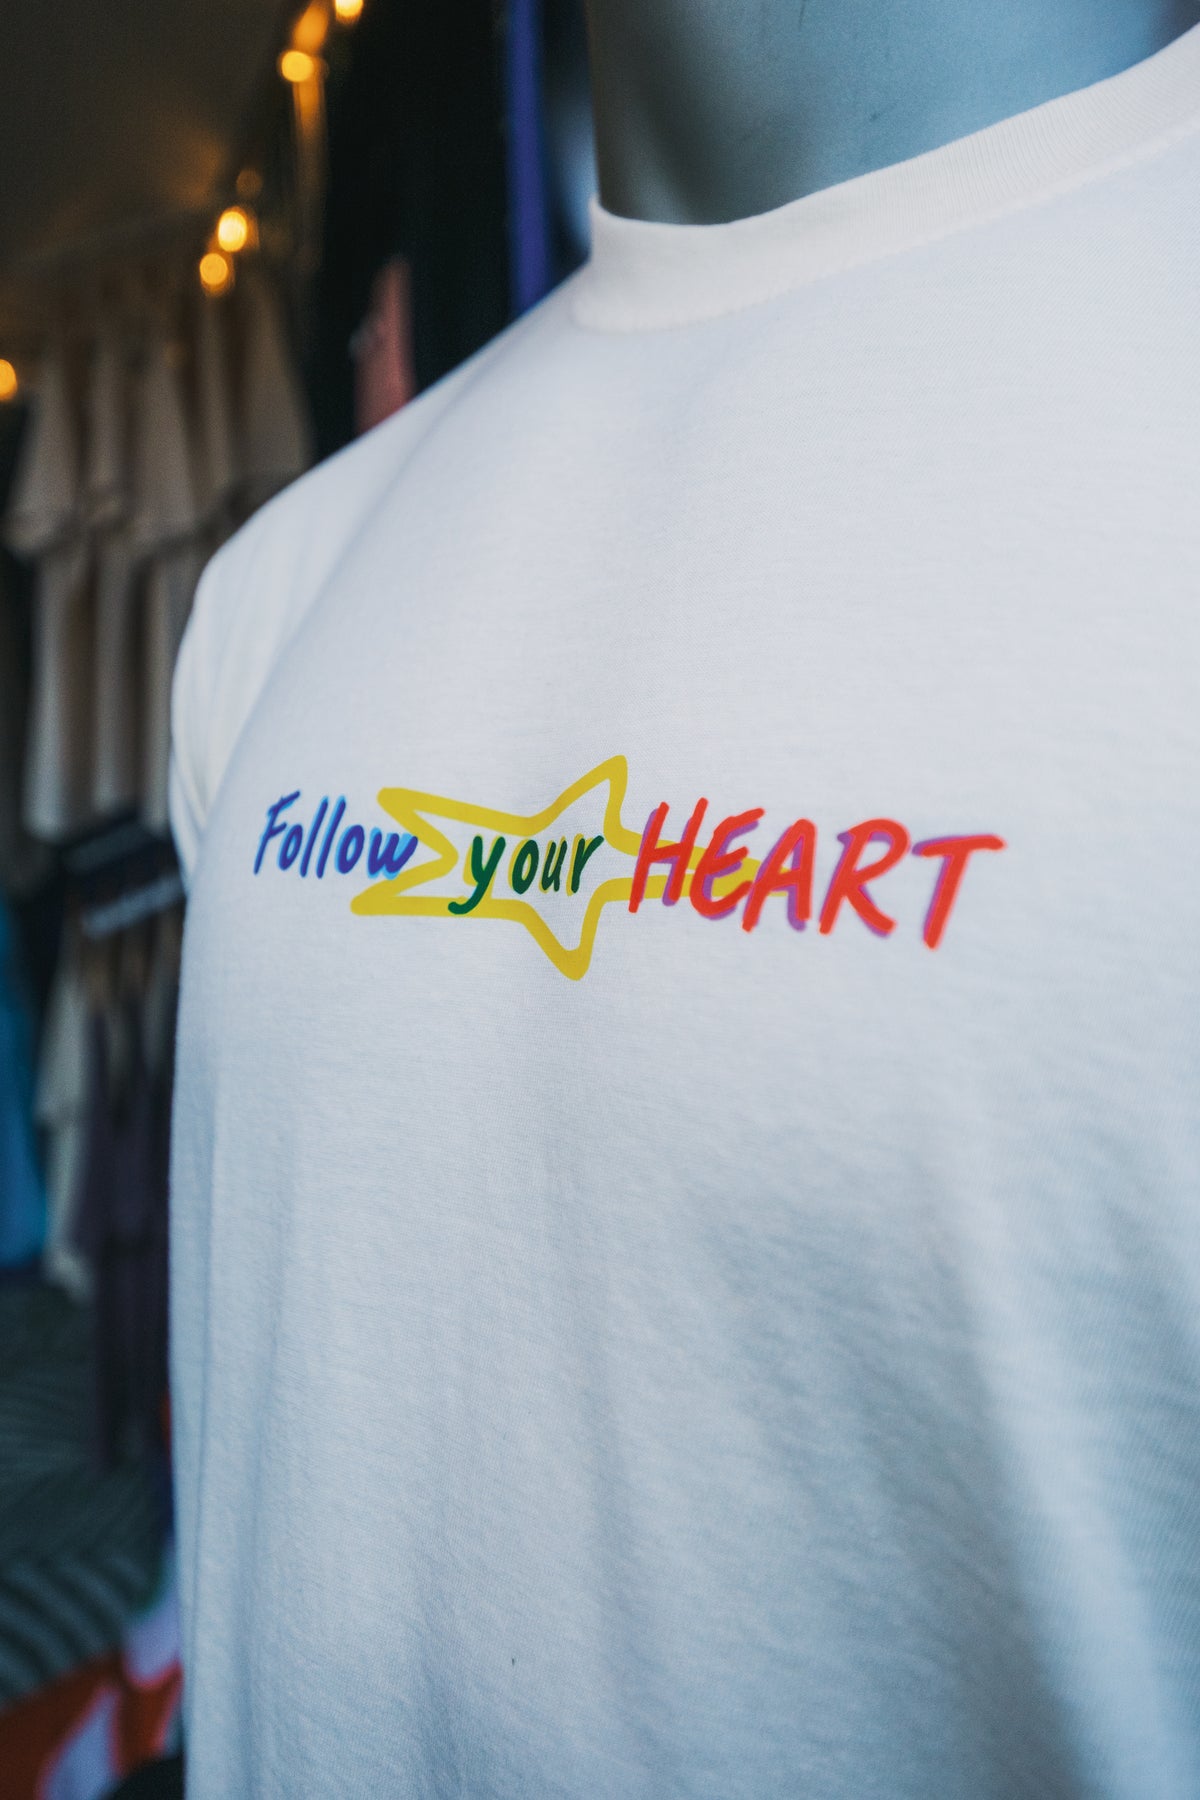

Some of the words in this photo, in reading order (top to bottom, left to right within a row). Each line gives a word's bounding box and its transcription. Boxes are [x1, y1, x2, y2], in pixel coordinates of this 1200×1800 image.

[253, 790, 419, 880] Follow
[447, 834, 605, 915] your
[628, 797, 1006, 950] HEART
